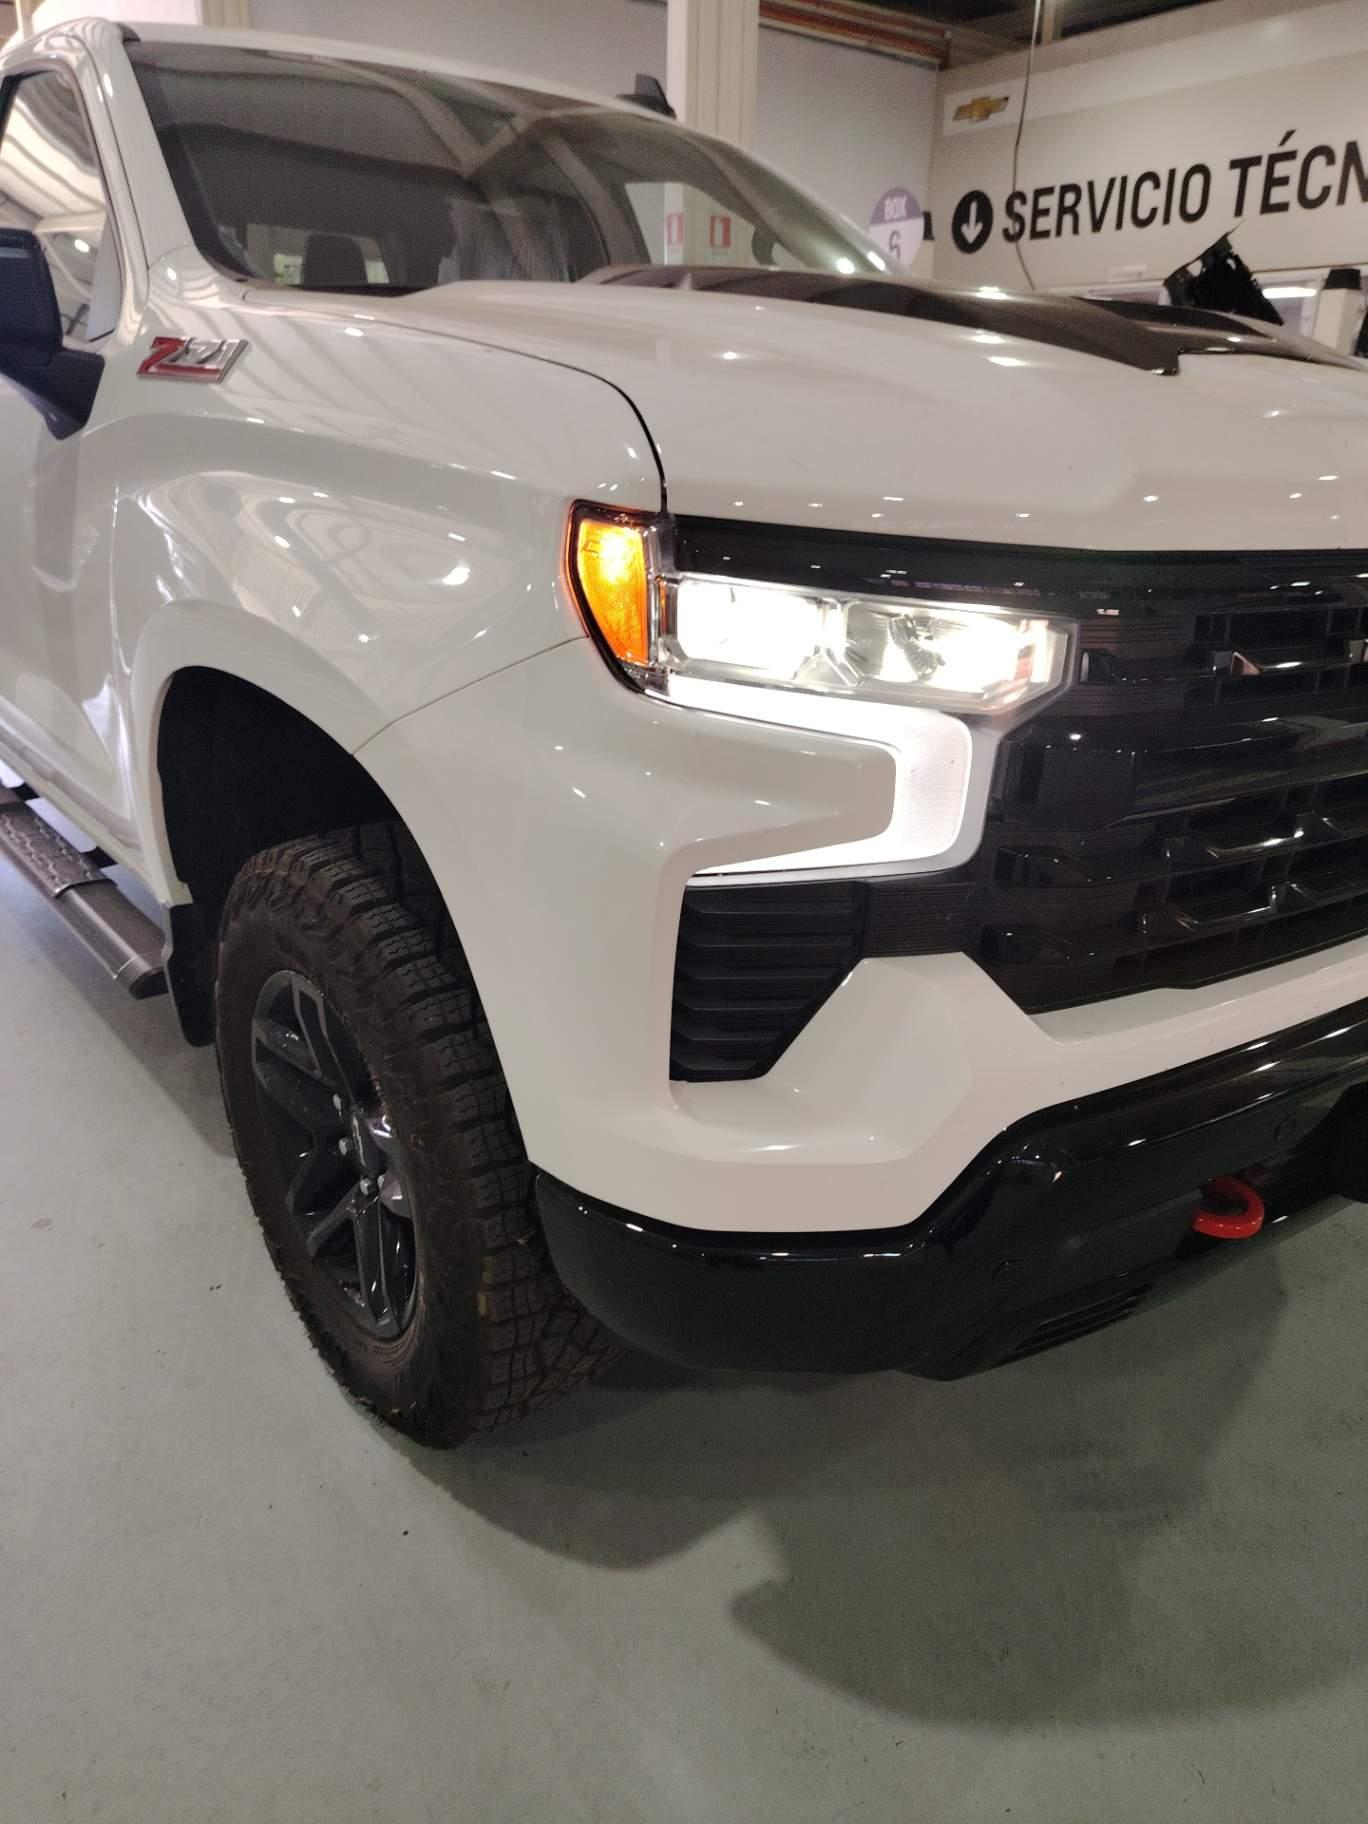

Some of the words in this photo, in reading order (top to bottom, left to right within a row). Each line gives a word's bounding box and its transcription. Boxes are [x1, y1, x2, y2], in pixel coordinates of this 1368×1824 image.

[884, 196, 907, 220] BOX
[1002, 163, 1211, 243] SERVICIO
[1228, 129, 1368, 218] TÉCN
[136, 336, 249, 384] Z71
